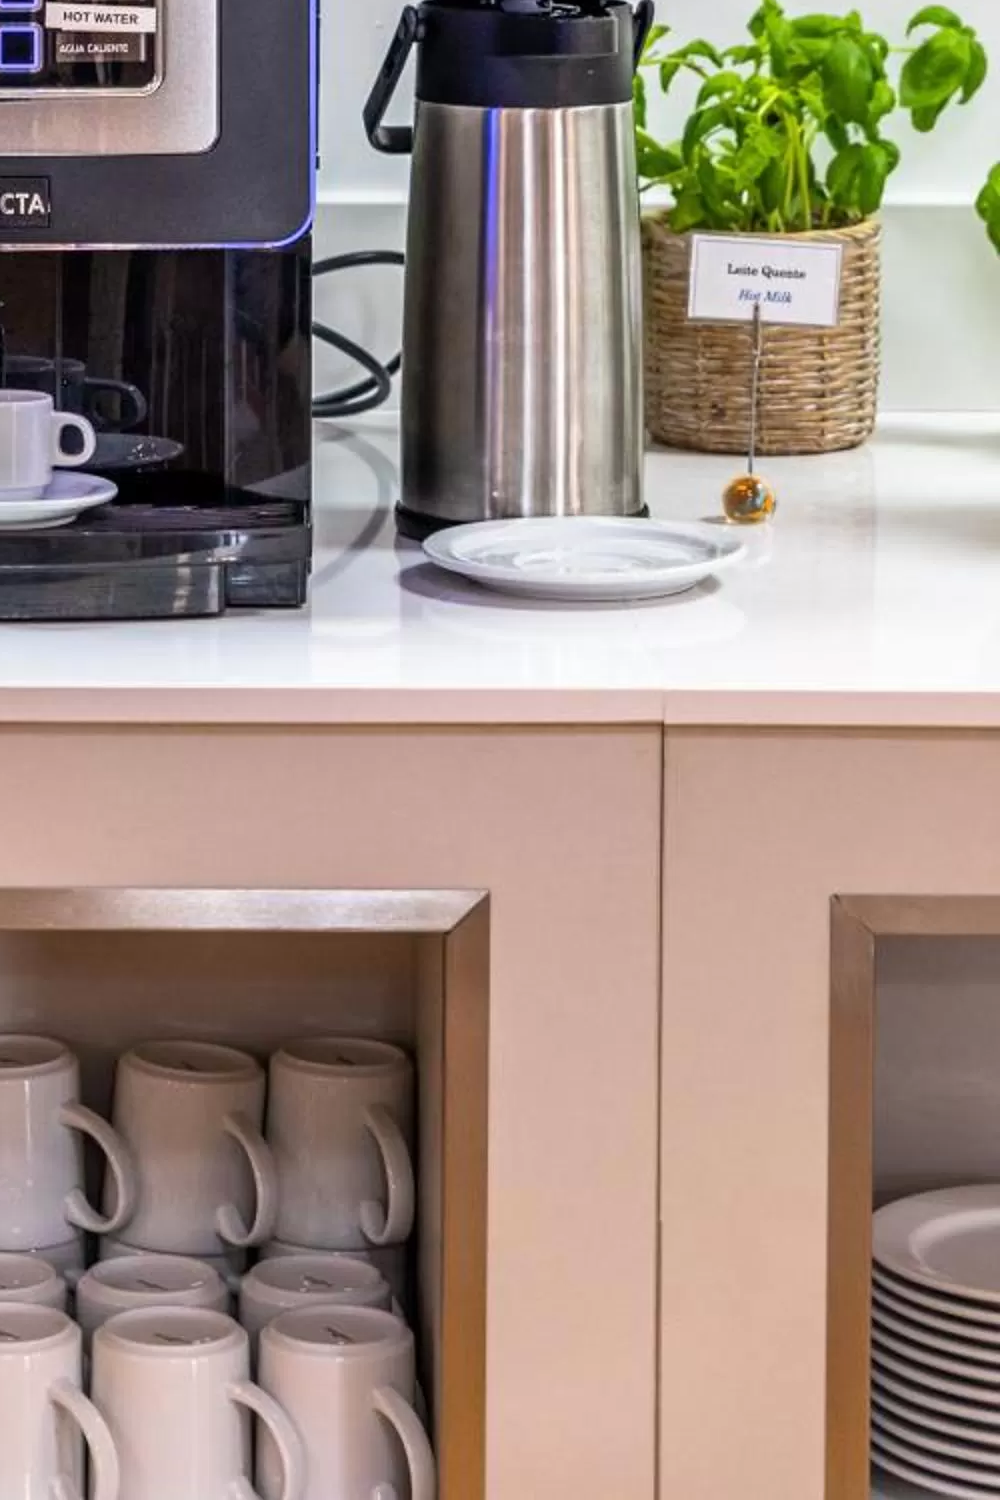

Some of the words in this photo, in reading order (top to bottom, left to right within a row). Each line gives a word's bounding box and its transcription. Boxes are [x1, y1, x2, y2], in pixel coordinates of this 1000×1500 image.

[63, 11, 91, 22] HOT
[93, 12, 139, 25] WATER
[59, 43, 85, 53] AGUA
[87, 43, 129, 53] CALIENTE
[727, 263, 758, 276] Leite
[761, 265, 806, 280] Quente
[738, 289, 760, 301] Hot
[763, 290, 792, 304] Milk
